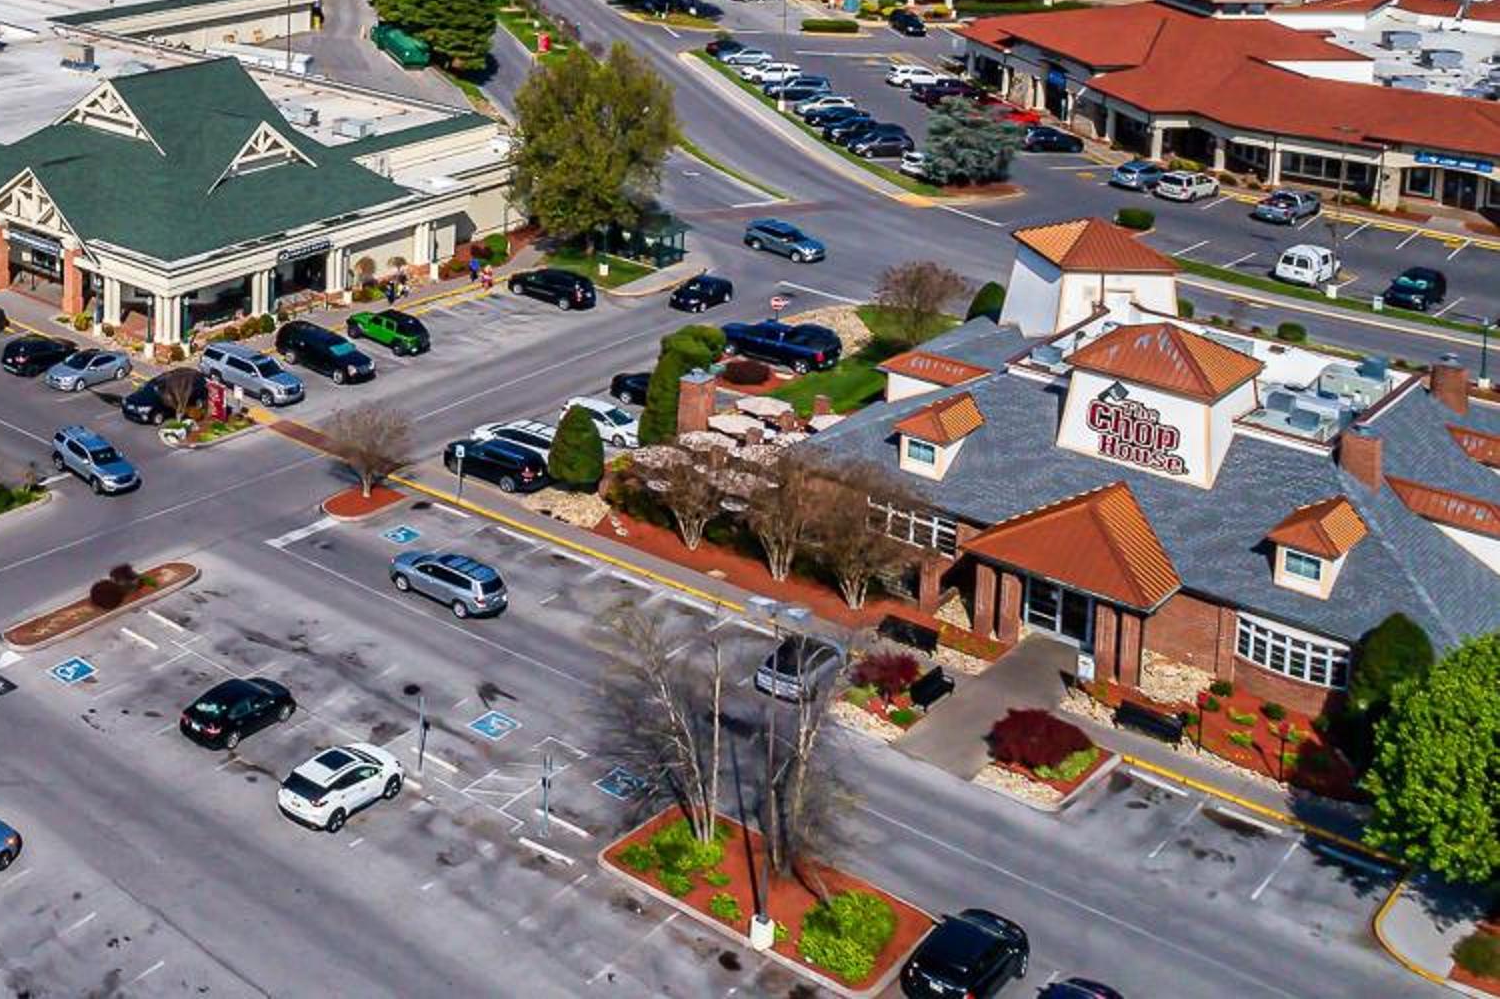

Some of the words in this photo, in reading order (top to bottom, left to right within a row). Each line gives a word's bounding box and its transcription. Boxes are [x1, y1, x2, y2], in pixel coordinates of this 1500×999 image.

[1087, 400, 1180, 451] Chop
[1121, 400, 1160, 422] The
[1098, 434, 1185, 475] House
